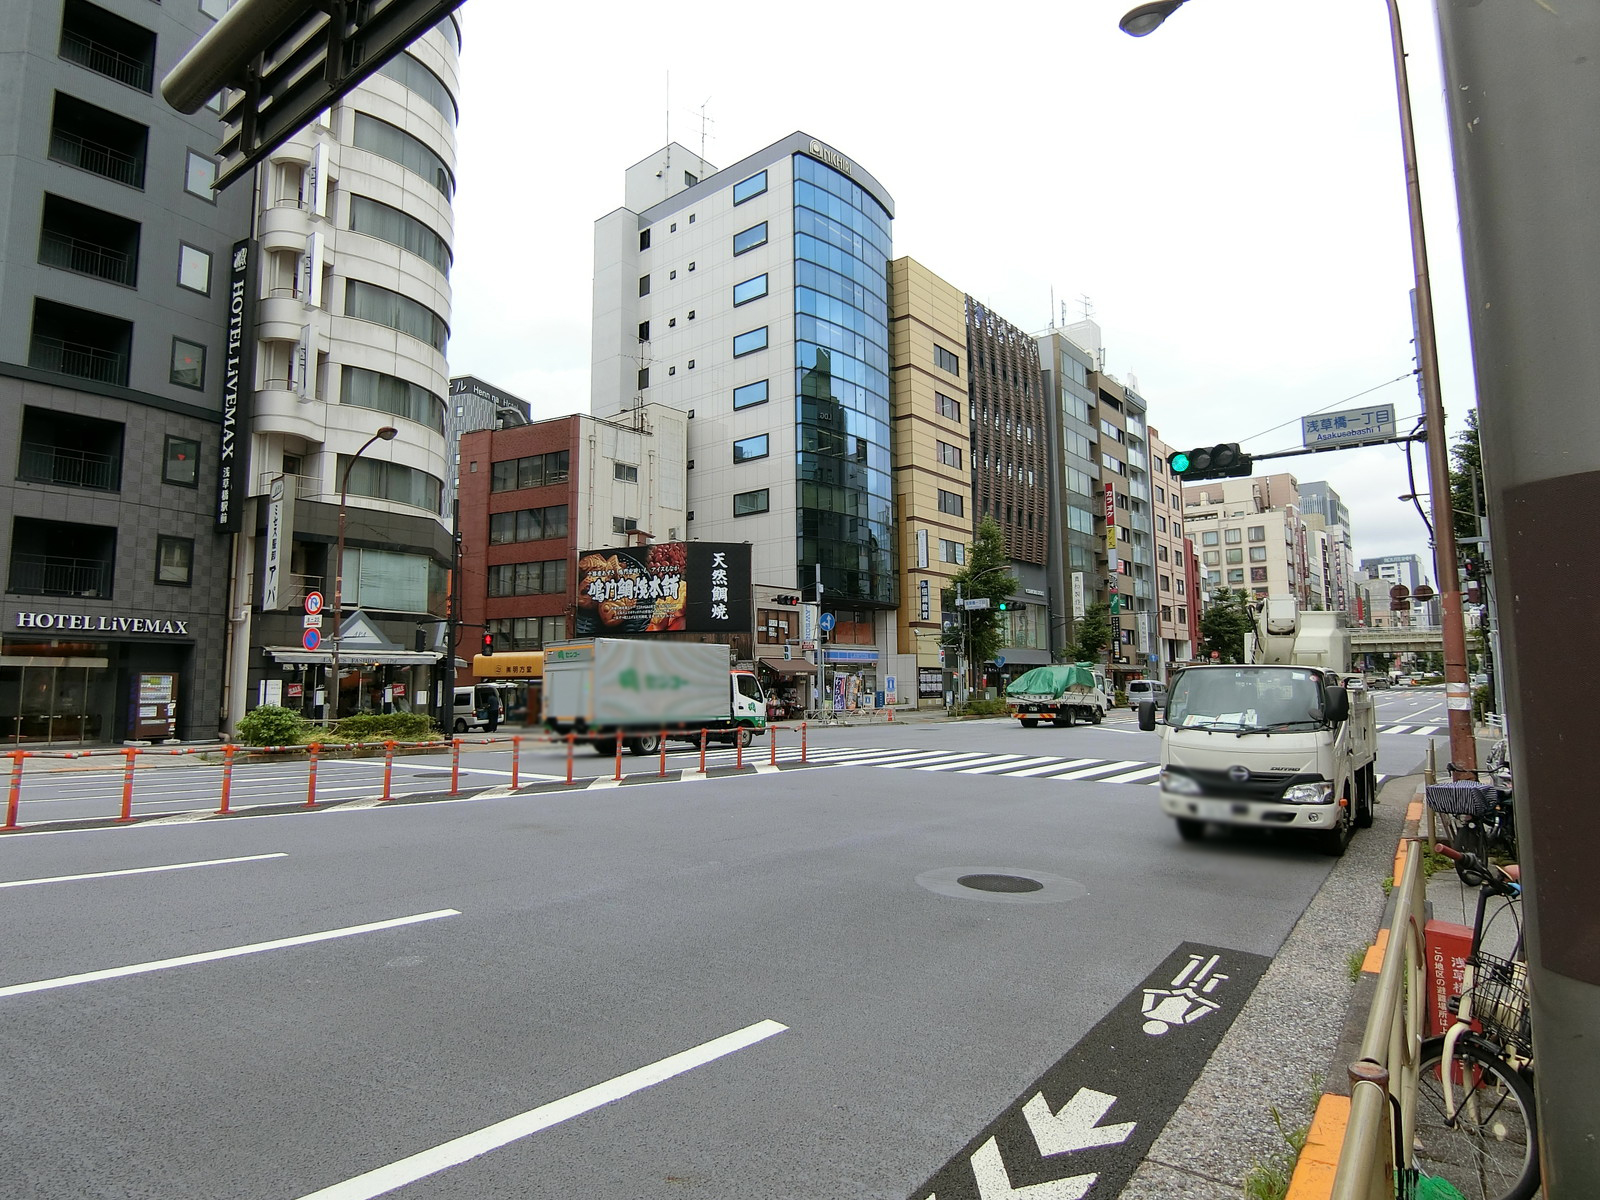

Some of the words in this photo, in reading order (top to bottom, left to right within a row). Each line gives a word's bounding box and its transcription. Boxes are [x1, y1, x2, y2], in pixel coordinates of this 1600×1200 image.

[229, 279, 245, 355] HOTEL
[222, 356, 239, 460] LiVEMAX
[473, 384, 491, 399] Henn
[491, 395, 500, 404] na
[1306, 409, 1390, 433] 浅草橋一丁目
[1316, 426, 1374, 441] Asakusabashi
[219, 466, 231, 524] 浅草橋駅前
[1106, 490, 1114, 518] カラオケ
[587, 574, 681, 603] 鳴門鯛焼本舗
[710, 552, 729, 621] 天然鯛焼
[16, 612, 96, 630] HOTEL
[97, 616, 188, 634] LiVEMAX
